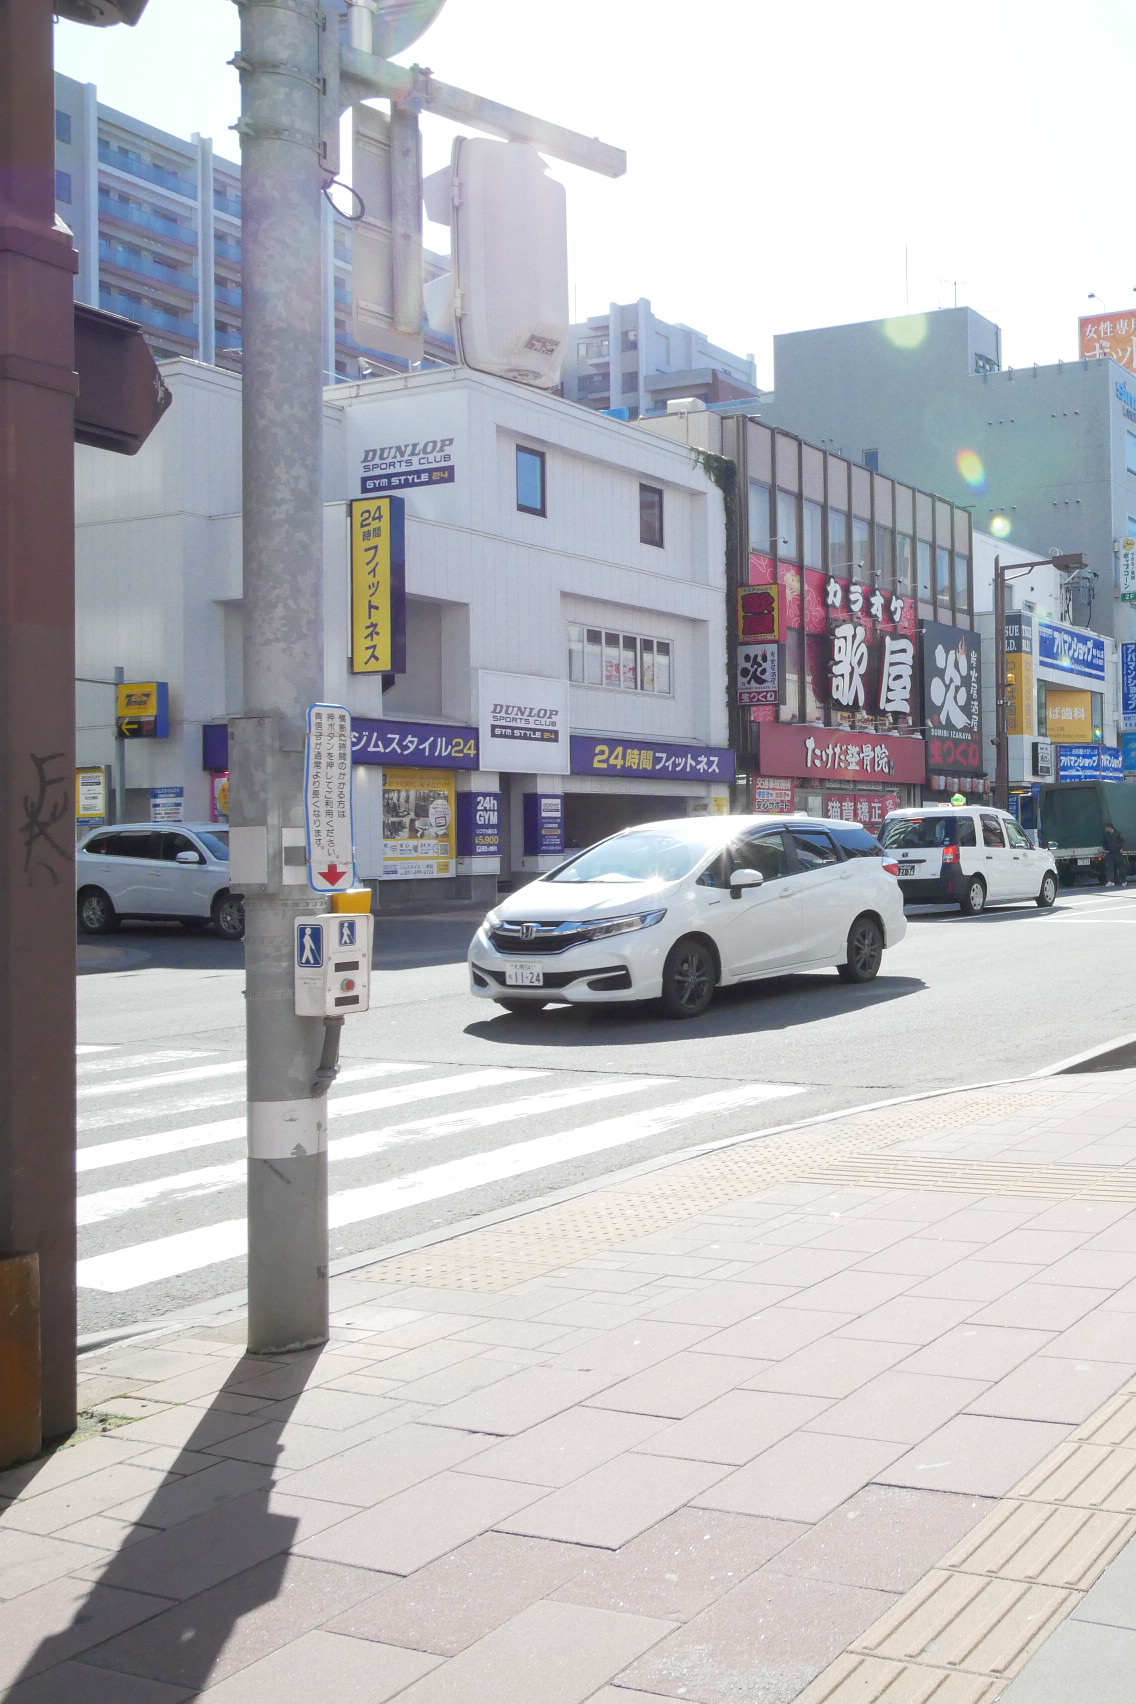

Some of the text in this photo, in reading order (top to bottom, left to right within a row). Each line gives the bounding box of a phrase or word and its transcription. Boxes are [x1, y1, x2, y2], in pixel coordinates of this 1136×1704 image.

[361, 438, 454, 463] DUNLOP
[363, 454, 451, 472] SPORTS CLUB
[366, 471, 448, 488] GYM STYLE 24
[360, 505, 383, 528] 24
[362, 526, 381, 542] 時間
[364, 545, 380, 665] フィットネス
[826, 577, 905, 622] カラオケ
[1004, 625, 1019, 636] SUE
[1053, 631, 1093, 662] アパマンショップ
[831, 623, 914, 713] 歌屋
[491, 703, 559, 719] DUNLOP
[492, 715, 556, 728] SPORTS CLUB
[495, 728, 555, 739] GYM STYLE 24
[931, 729, 972, 740] SUMIBI IZAKAYA
[352, 731, 477, 758] ジムスタイル24
[593, 745, 720, 773] 24時間フィットネス
[805, 737, 889, 773] たけだ整骨院
[1060, 756, 1098, 767] アパマンショップ
[337, 714, 347, 818] 横断に時間のかかる方は
[476, 796, 497, 810] 24h
[756, 800, 790, 811] 安心サポート
[828, 799, 882, 822] 猫背矯正
[476, 811, 497, 824] GYM
[514, 971, 541, 984] 11-24
